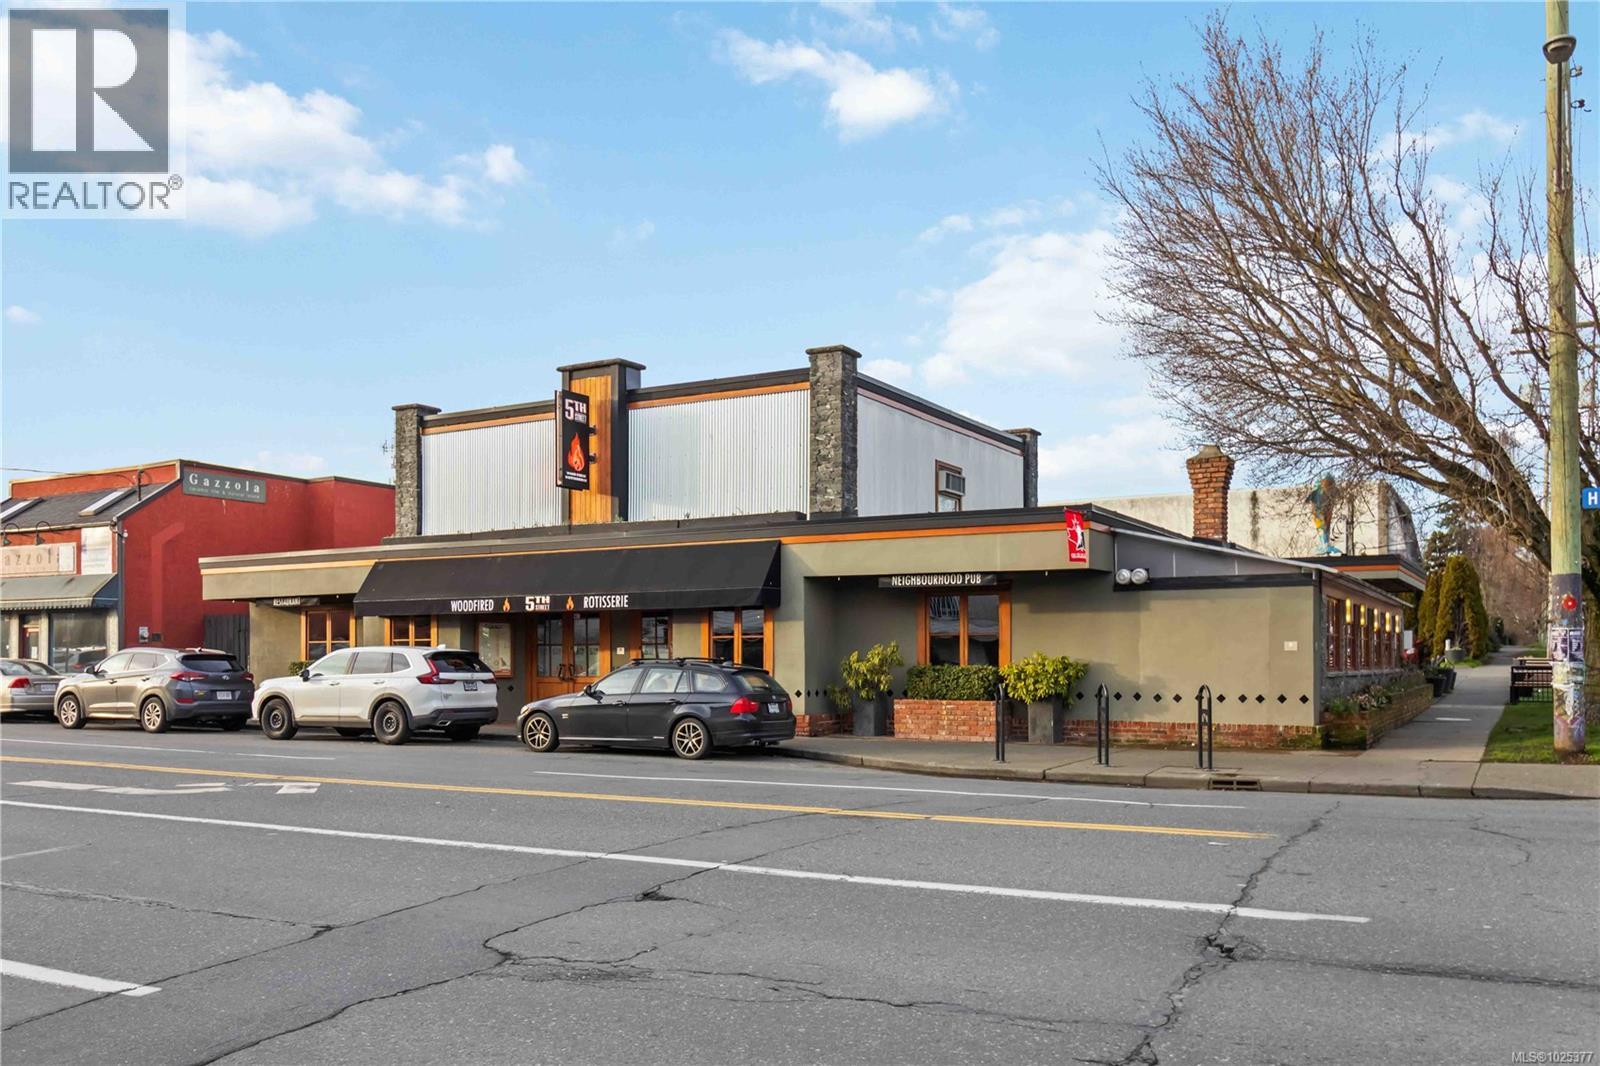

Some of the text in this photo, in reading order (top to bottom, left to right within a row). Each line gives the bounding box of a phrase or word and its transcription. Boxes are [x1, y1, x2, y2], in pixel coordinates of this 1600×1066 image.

[564, 398, 587, 421] 5TH
[189, 473, 260, 493] Gazzola
[1588, 491, 1598, 506] H
[891, 573, 982, 586] NEIGHBOURHOOD PUB
[450, 595, 629, 612] WOODFIRED 5TH ROTISSERIE
